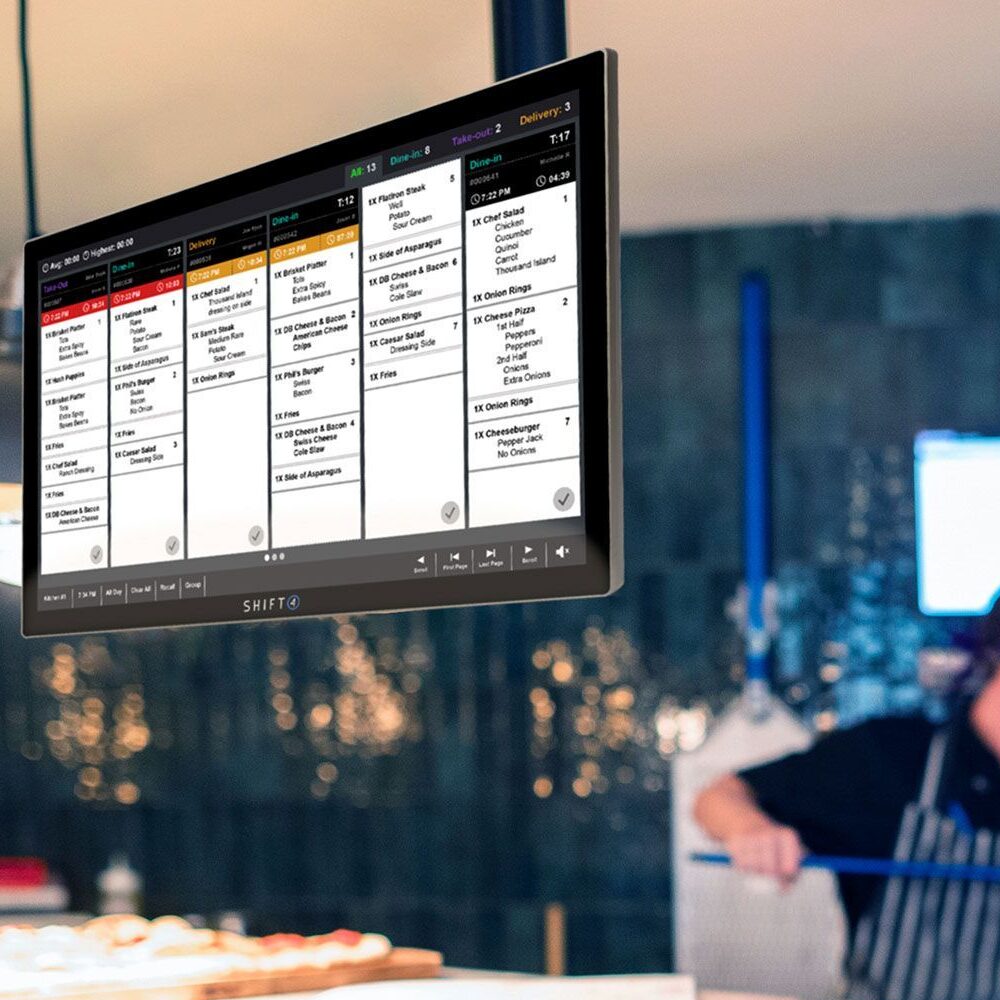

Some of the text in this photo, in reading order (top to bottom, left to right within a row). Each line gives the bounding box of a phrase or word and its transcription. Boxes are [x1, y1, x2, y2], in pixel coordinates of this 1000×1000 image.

[520, 102, 571, 125] Delivery: 3
[452, 123, 502, 146] Take-out: 2
[550, 130, 570, 144] T:17
[390, 146, 430, 165] Dine-in: 8
[470, 155, 502, 170] Dine-in
[450, 174, 455, 182] 5
[549, 171, 570, 183] 04:39
[337, 195, 355, 207] T:12
[368, 184, 426, 206] 1X Flatiron Steak
[481, 187, 511, 201] 7:22 PM
[272, 212, 299, 226] Dine-in
[389, 210, 410, 221] Potato
[393, 214, 432, 231] Sour Cream
[472, 206, 525, 226] 1X Chef Salad
[495, 219, 524, 231] Chicken
[495, 228, 533, 243] Cucumber
[379, 250, 394, 260] Side
[396, 247, 403, 255] of
[404, 238, 442, 253] Asparagus
[452, 258, 457, 266] 6
[495, 253, 518, 265] Carrot
[495, 255, 556, 275] Thousand Island
[369, 278, 378, 286] 1X
[379, 275, 389, 284] DB
[391, 269, 417, 281] Cheese
[426, 261, 449, 273] Bacon
[473, 284, 532, 303] 1X Onion Rings
[563, 298, 568, 306] 2
[370, 311, 422, 328] 1X Onion Rings
[474, 306, 535, 325] 1X Cheese Pizza
[453, 322, 458, 330] 7
[497, 318, 524, 331] 1st Half
[293, 324, 348, 341] American Cheese
[370, 330, 425, 348] 1X Caesar Salad
[505, 328, 536, 340] Peppers
[293, 343, 312, 351] Chips
[390, 339, 436, 354] Dressing Side
[505, 337, 543, 351] Pepperoni
[497, 351, 527, 365] 2nd Half
[380, 371, 397, 380] Fries
[503, 364, 529, 374] Onions
[504, 371, 551, 385] Extra Onions
[486, 401, 508, 411] Onion
[511, 397, 533, 407] Rings
[284, 411, 299, 419] Fries
[565, 417, 570, 426] 7
[284, 430, 293, 438] DB
[295, 427, 318, 437] Cheese
[326, 422, 347, 431] Bacon
[486, 423, 540, 438] Cheeseburger
[498, 434, 543, 447] Pepper Jack
[498, 447, 536, 458] No Onions
[285, 473, 298, 481] Side
[307, 468, 341, 478] Asparagus
